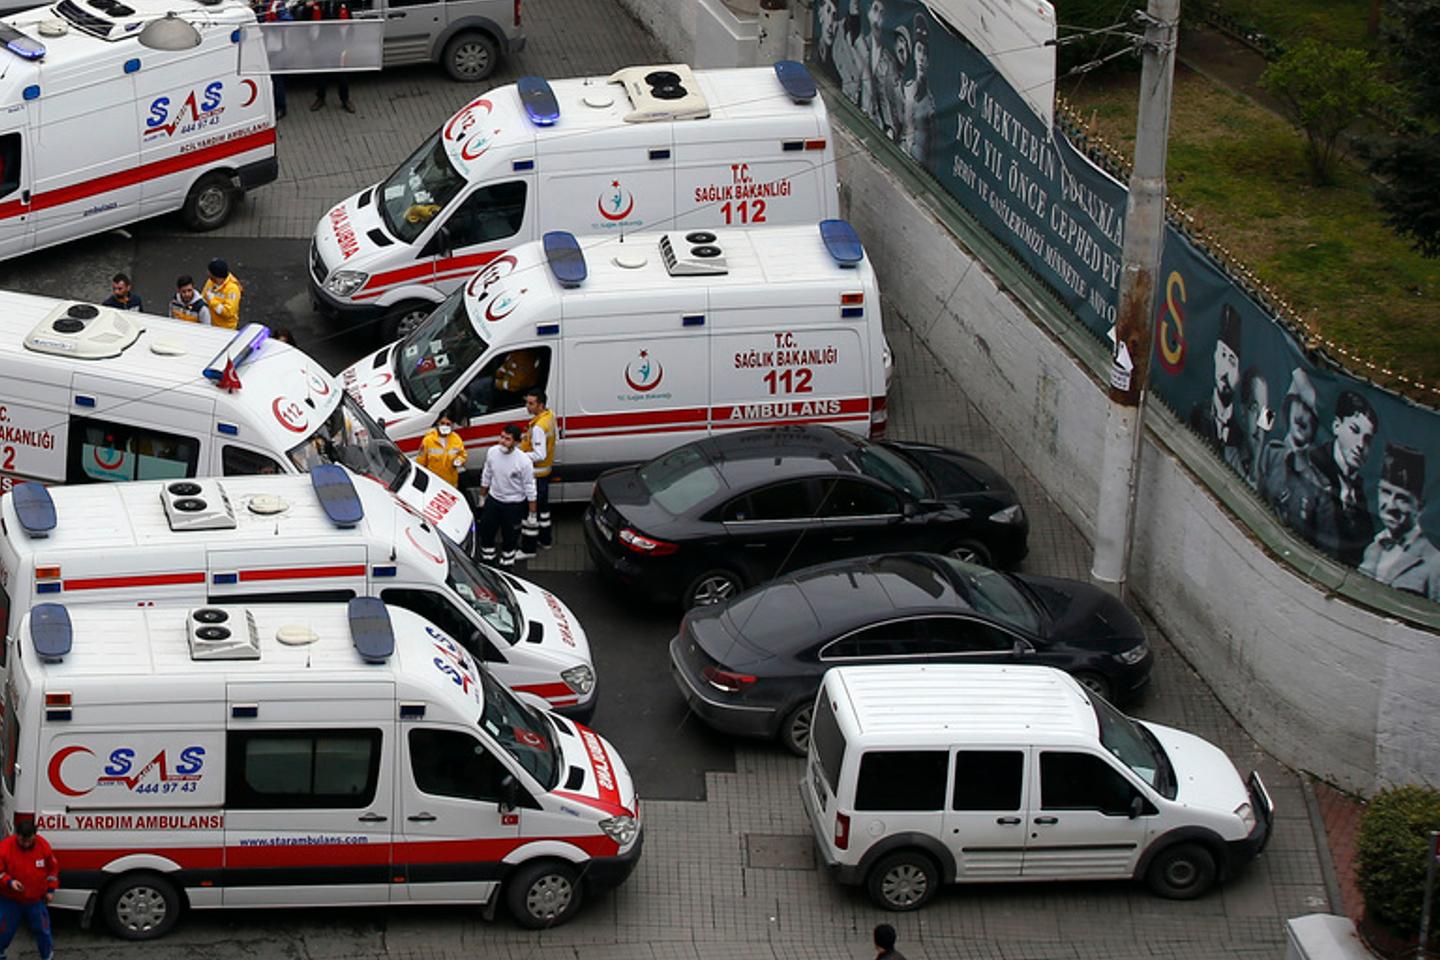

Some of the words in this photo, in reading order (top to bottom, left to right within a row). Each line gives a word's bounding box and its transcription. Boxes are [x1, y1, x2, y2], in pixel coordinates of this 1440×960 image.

[958, 71, 978, 108] BU
[981, 92, 1056, 181] MEKTEBİN
[1061, 162, 1123, 248] ÇOCUKLA
[731, 164, 751, 182] T.C.
[695, 185, 732, 202] SAĞLIK
[735, 179, 791, 199] BAKANLIĞI
[720, 200, 767, 225] 112
[956, 114, 981, 157] YÜZ
[984, 139, 1003, 181] YIL
[1009, 159, 1048, 218] ÖNCE
[1051, 203, 1121, 290] CEPHEDEY
[978, 177, 988, 202] VE
[1090, 287, 1118, 323] ANIYO
[774, 333, 796, 348] T.C.
[734, 352, 773, 369] SAĞLIK
[776, 348, 837, 366] BAKANLIĞI
[763, 369, 814, 395] 112
[282, 403, 304, 424] 112
[729, 401, 841, 420] AMBULANS
[136, 783, 159, 793] 444
[163, 783, 177, 793] 97
[181, 782, 197, 792] 43
[37, 813, 70, 828] ACİL
[75, 816, 132, 829] YARDIM
[135, 816, 224, 829] AMBULANSI
[240, 835, 368, 846] www.starambulans.com
